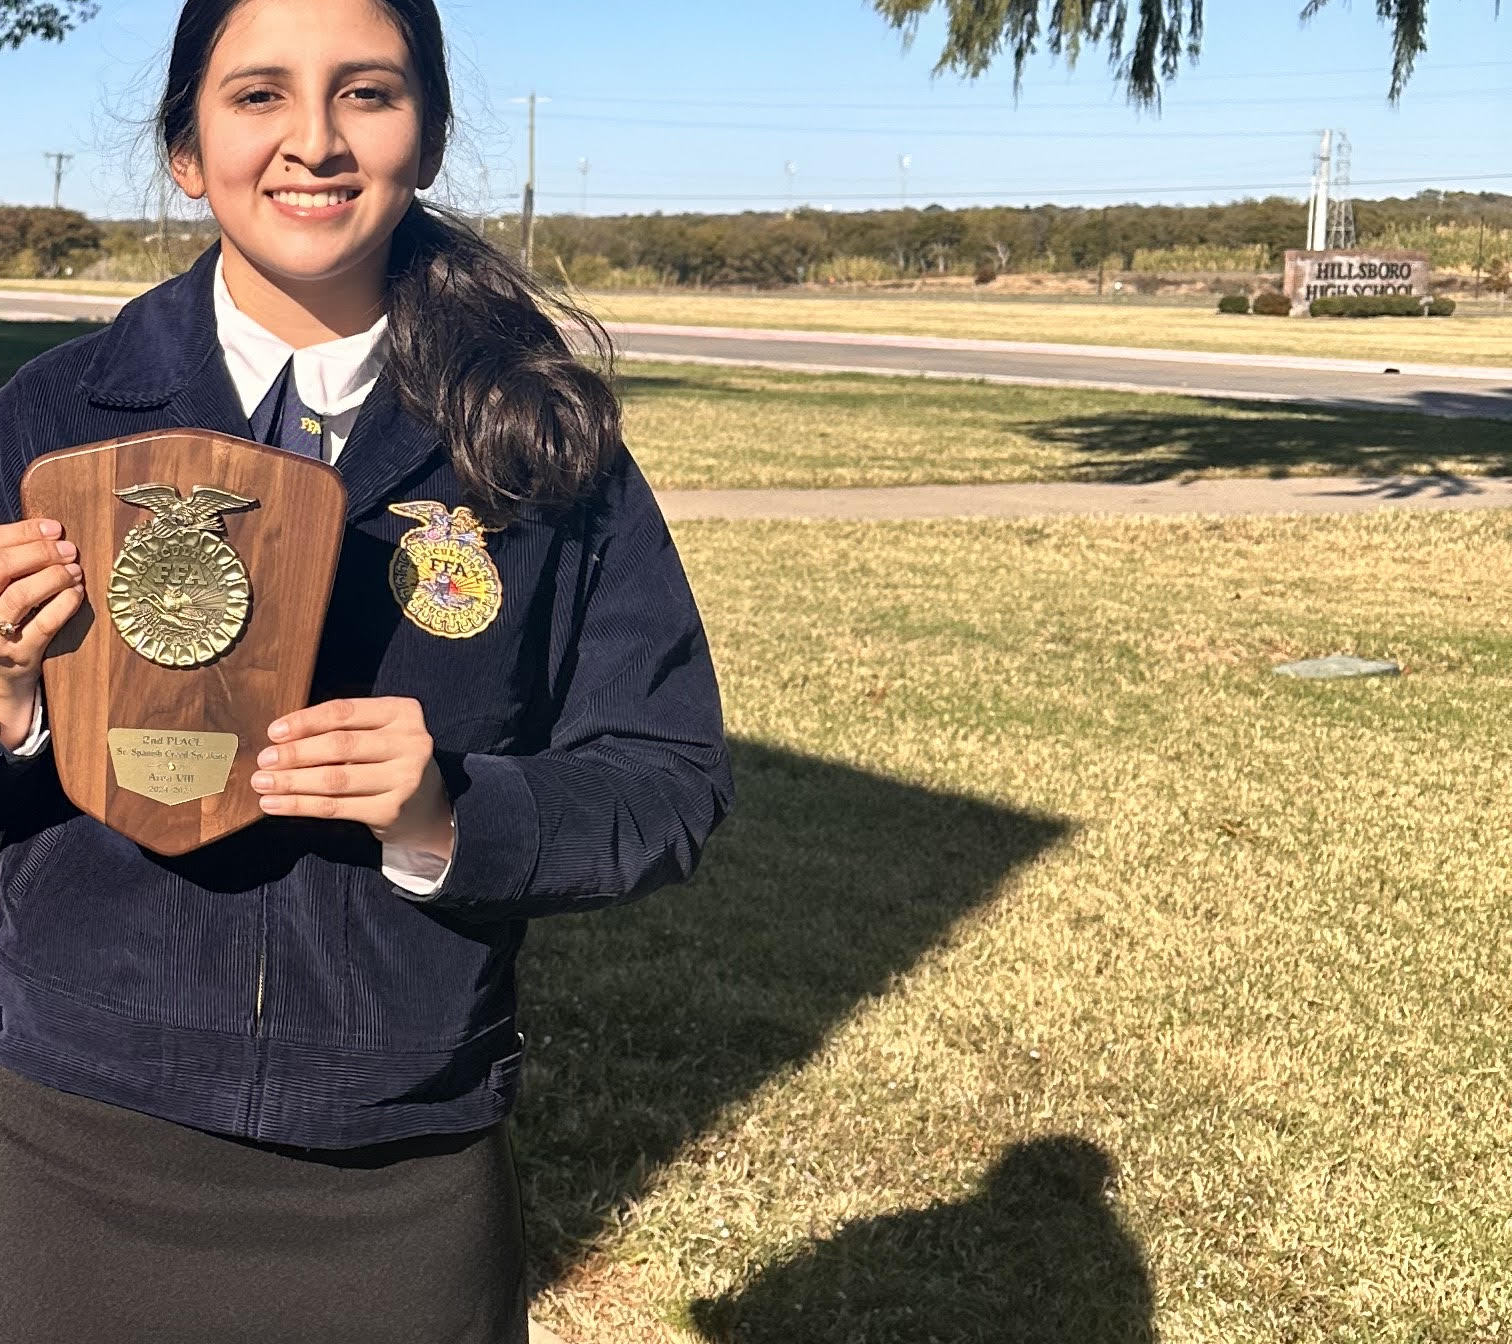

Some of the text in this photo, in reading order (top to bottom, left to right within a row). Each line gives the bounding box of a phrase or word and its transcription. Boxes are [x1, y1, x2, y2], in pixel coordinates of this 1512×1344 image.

[1316, 262, 1412, 281] HILLSBORO
[1305, 283, 1414, 301] HIGH SCHOOL
[153, 562, 208, 586] FFA
[414, 547, 483, 585] GRICULTURAL
[430, 558, 468, 578] FFA
[142, 735, 164, 745] 2nd
[148, 773, 173, 783] Area
